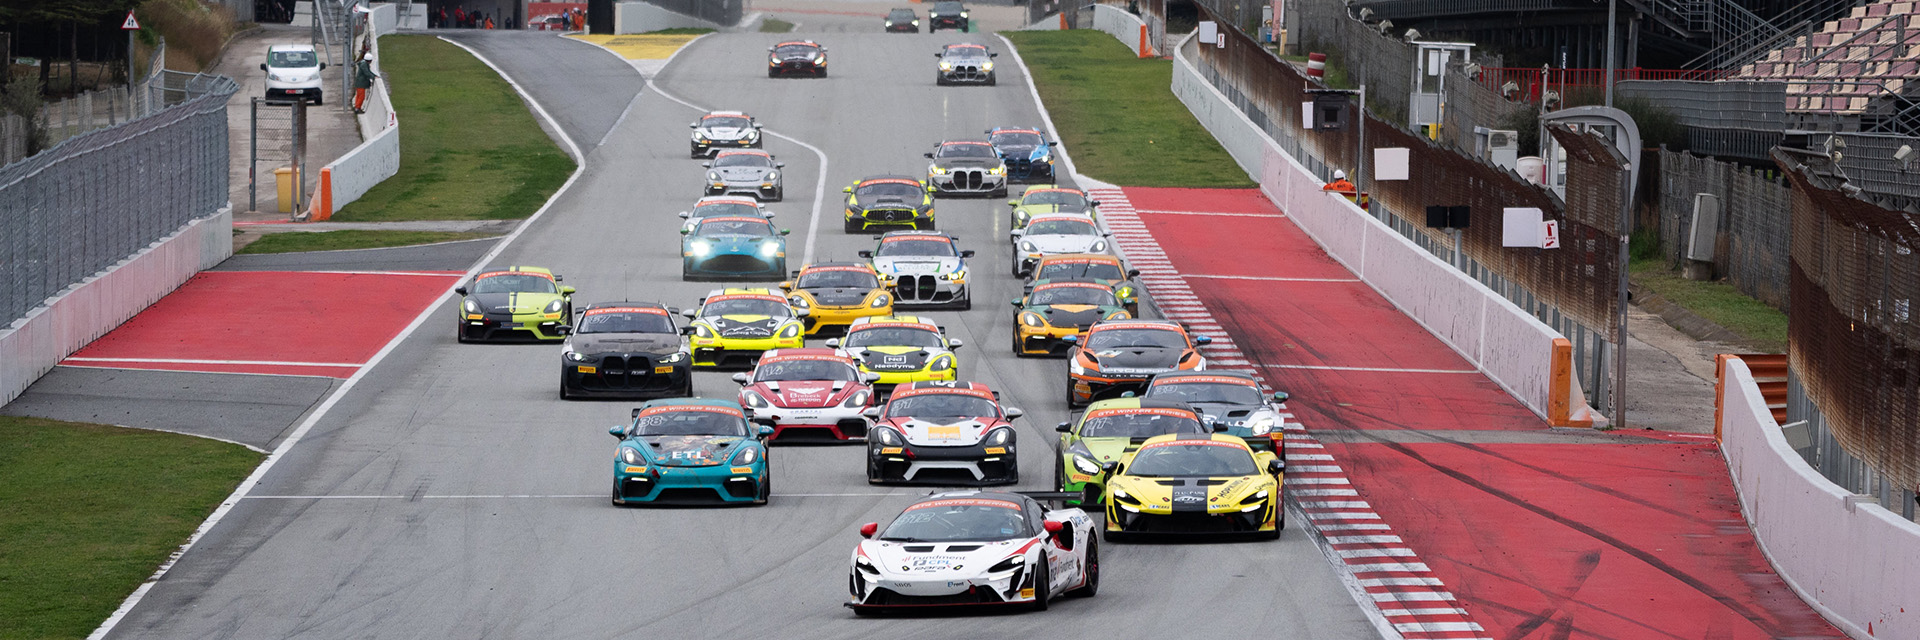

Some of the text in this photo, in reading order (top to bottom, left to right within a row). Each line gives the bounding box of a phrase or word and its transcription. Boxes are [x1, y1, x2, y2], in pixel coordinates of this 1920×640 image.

[953, 389, 985, 397] SERIES
[705, 407, 738, 415] SERIES
[639, 415, 663, 427] 38
[1206, 440, 1241, 448] SERIES
[672, 450, 706, 459] ETL
[980, 500, 1017, 508] SERIES
